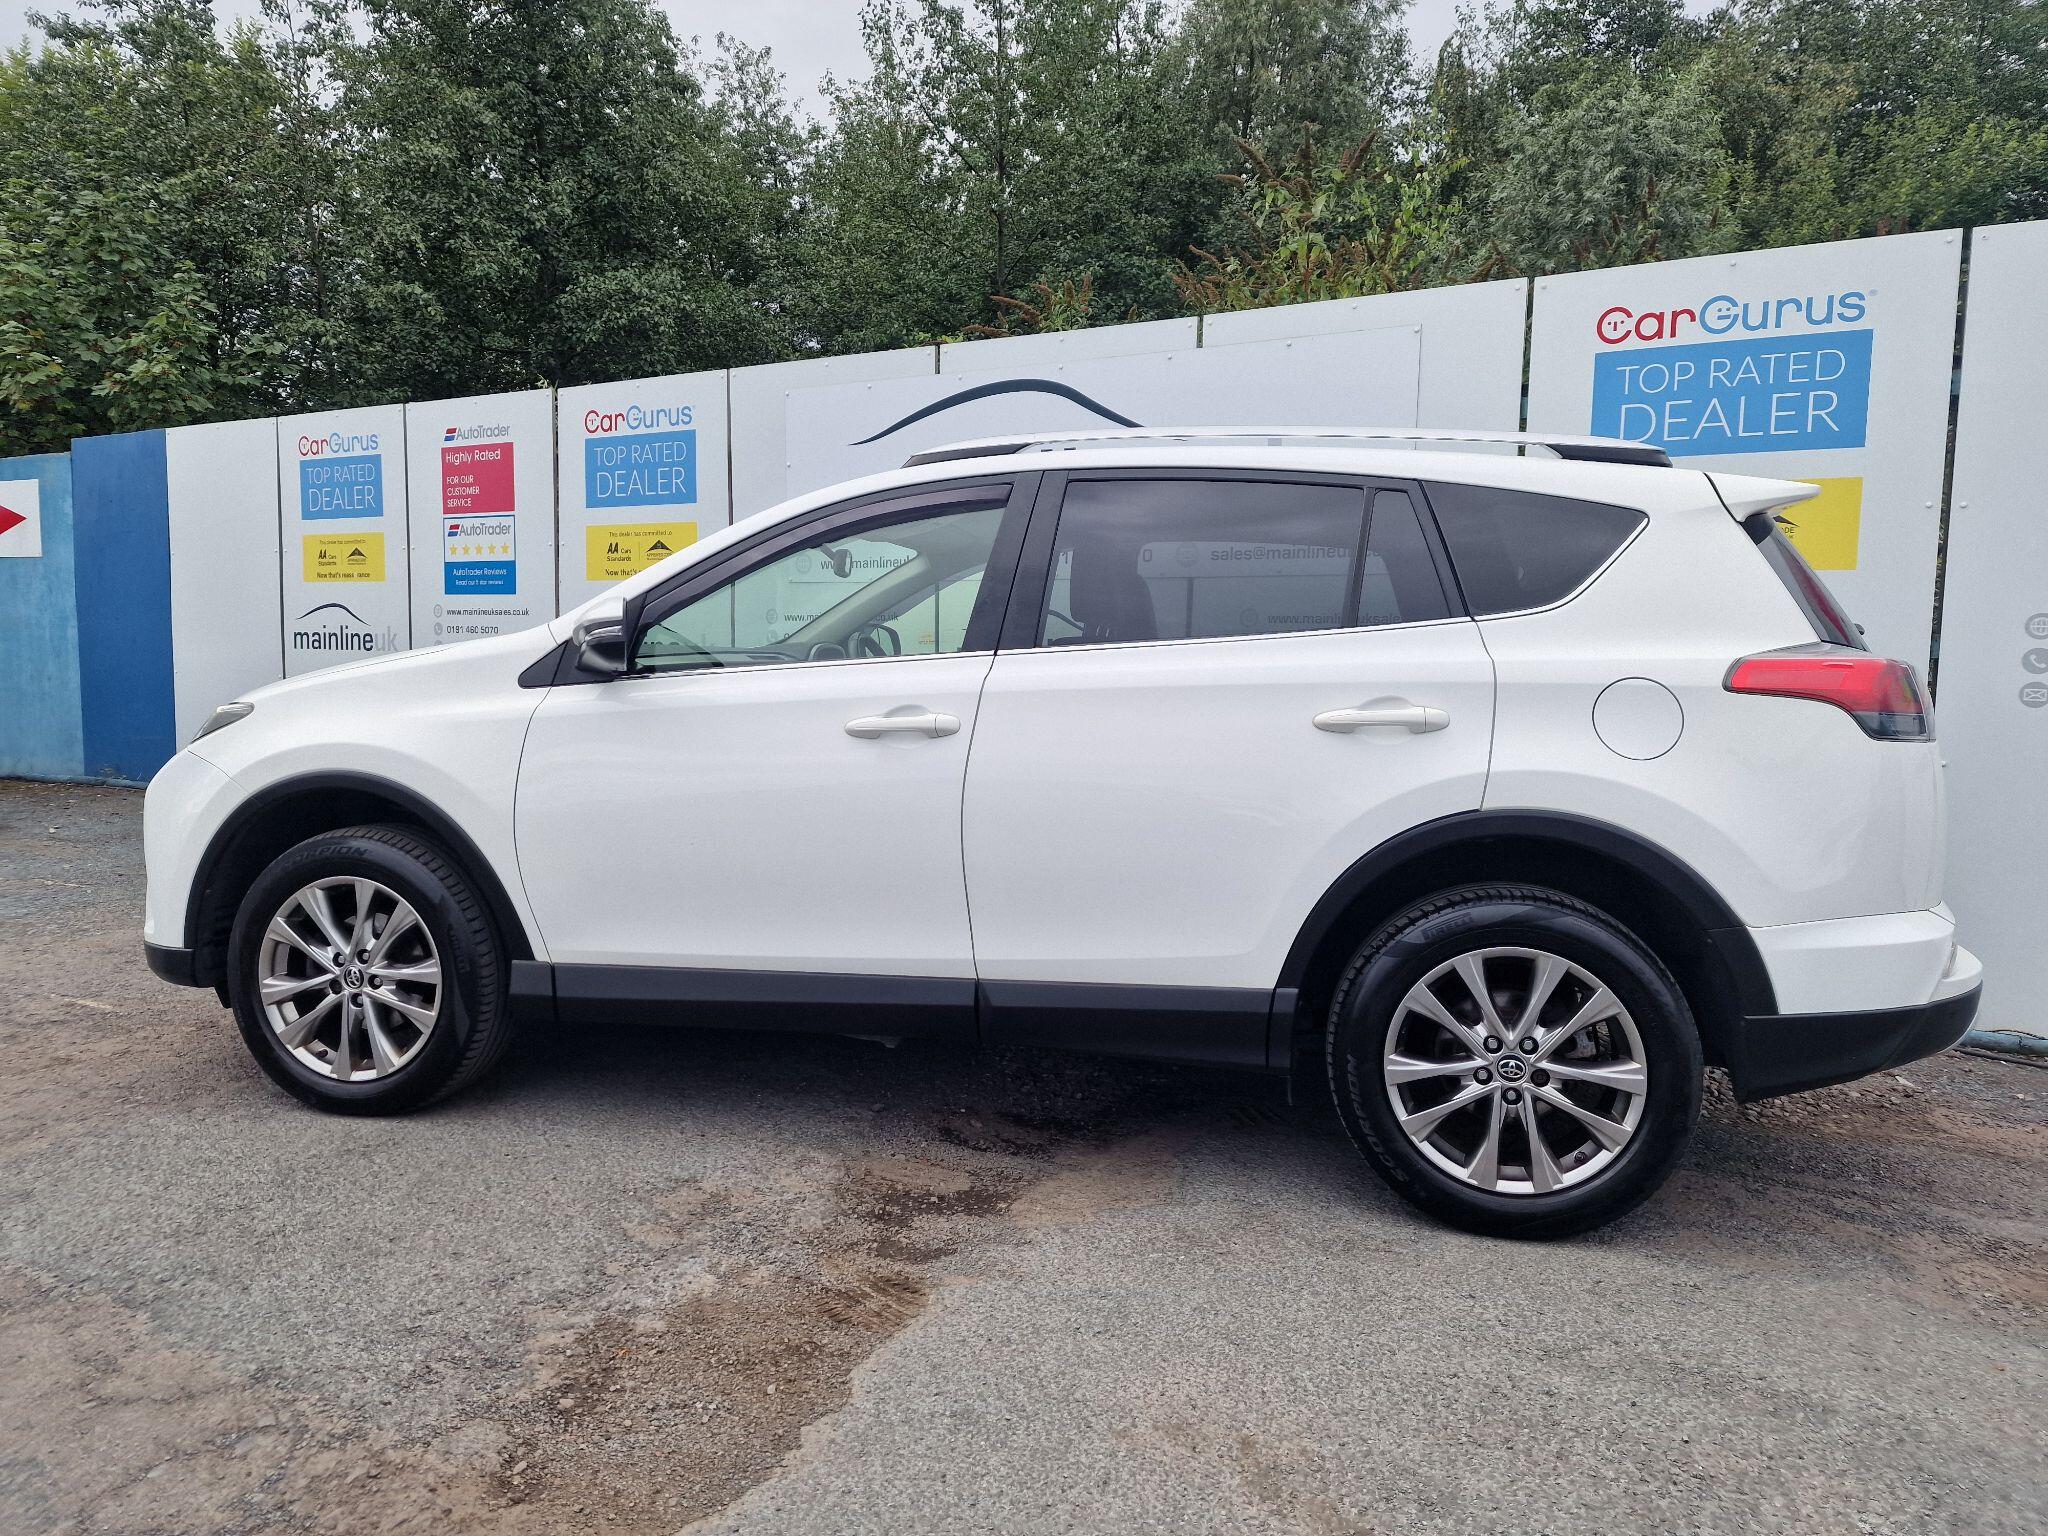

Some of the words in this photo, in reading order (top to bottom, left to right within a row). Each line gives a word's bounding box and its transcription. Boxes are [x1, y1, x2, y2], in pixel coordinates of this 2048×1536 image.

[1596, 291, 1866, 344] CarGurus
[1616, 361, 1695, 395] TOP
[1709, 349, 1846, 389] RATED
[584, 405, 693, 434] CarGurus
[1619, 390, 1840, 442] DEALER
[455, 424, 511, 441] AutoTrader
[298, 432, 379, 457] CarGurus
[593, 446, 627, 466] TOP
[631, 441, 687, 464] RATED
[446, 450, 473, 465] Highly
[474, 448, 501, 461] Rated
[305, 466, 331, 485] TOP
[334, 463, 375, 483] RATED
[446, 475, 459, 484] FOR
[460, 474, 474, 484] OUR
[596, 467, 687, 498] DEALER
[308, 485, 376, 511] DEALER
[446, 485, 480, 496] CUSTOMER
[447, 498, 472, 508] SERVICE
[459, 522, 512, 537] AutoTrader
[317, 549, 327, 559] AA
[606, 542, 619, 554] AA
[604, 568, 619, 576] Now
[620, 567, 637, 576] that's
